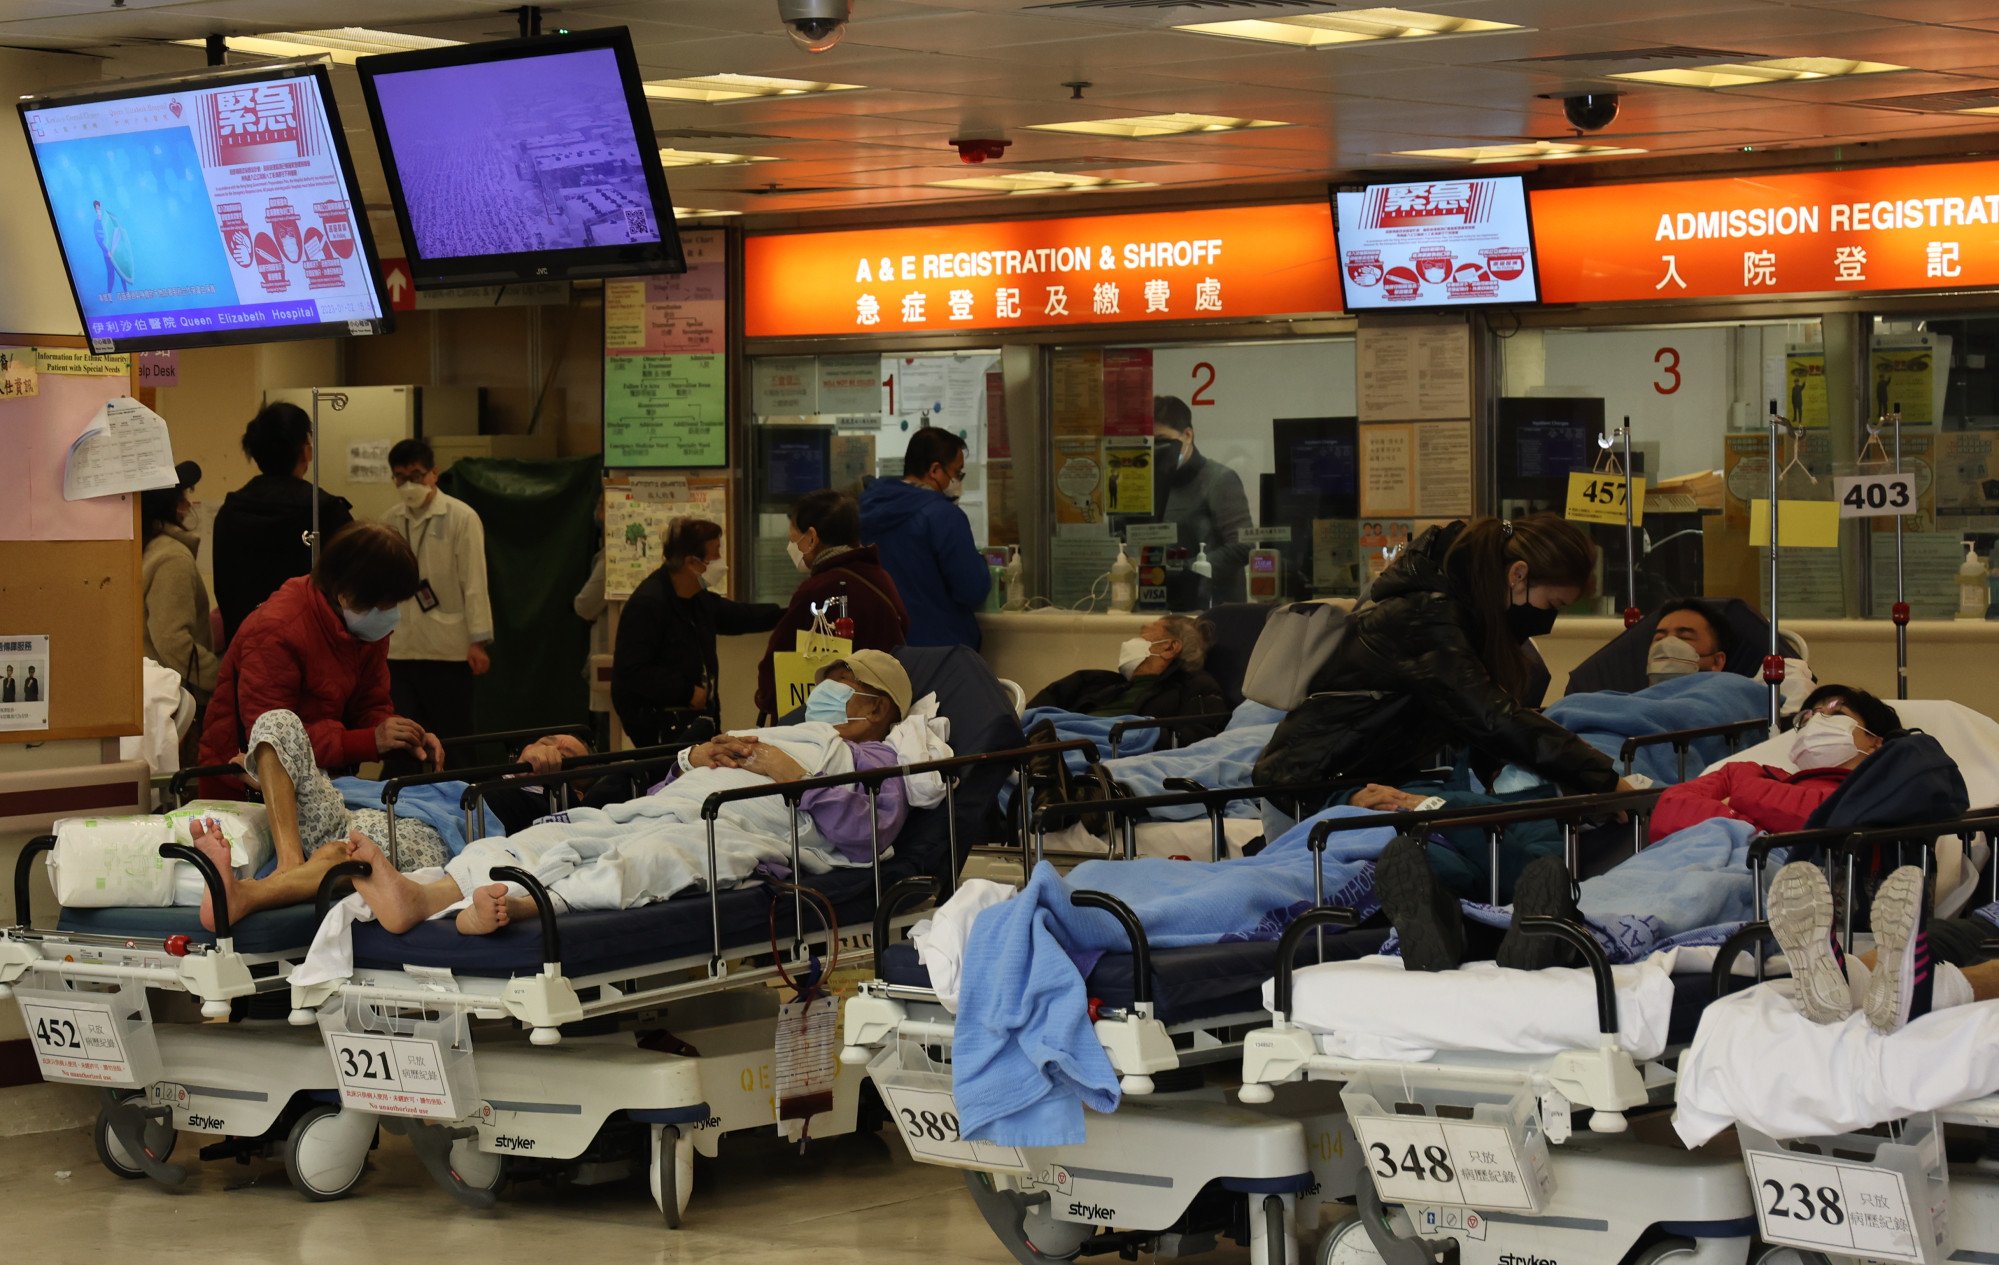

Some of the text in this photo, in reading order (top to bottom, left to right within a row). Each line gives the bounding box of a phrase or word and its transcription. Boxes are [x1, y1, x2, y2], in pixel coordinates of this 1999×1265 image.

[217, 86, 297, 136] 緊急
[1385, 183, 1471, 213] 緊急
[1655, 206, 1818, 242] ADMISSION
[536, 267, 548, 275] JVC
[856, 239, 1223, 283] A & E REGISTRATION & SHROFF
[1655, 242, 1962, 291] 入院登記
[856, 277, 1223, 325] 急症登記及繳費處
[91, 306, 314, 335] 伊利沙伯醫院 Queen Elizabeth Hospital
[37, 352, 73, 362] Information
[73, 352, 83, 361] for
[104, 354, 128, 364] Minority
[46, 363, 68, 372] Patient
[83, 364, 103, 374] Special
[104, 365, 121, 373] Needs
[153, 364, 176, 377] Desk
[1653, 346, 1681, 395] 3
[882, 373, 894, 415] 1
[1191, 361, 1216, 406] 2
[1582, 480, 1626, 506] 457
[1843, 481, 1910, 509] 403
[1142, 589, 1166, 600] VISA
[36, 1017, 81, 1049] 452
[340, 1047, 395, 1081] 321
[407, 1055, 425, 1066] 只放
[70, 1070, 103, 1080] unauthorized
[369, 1102, 379, 1110] No
[379, 1103, 417, 1114] unauthorized
[188, 1113, 225, 1131] stryker
[693, 1115, 722, 1130] ryker
[901, 1107, 960, 1142] 389
[495, 1135, 536, 1150] stryker
[1370, 1142, 1455, 1183] 348
[1469, 1150, 1498, 1165] 只放
[1461, 1168, 1518, 1185] 病歷紀錄
[1068, 1201, 1116, 1220] stryker
[1762, 1178, 1845, 1226] 238
[1860, 1192, 1889, 1209] 只放
[1850, 1211, 1908, 1232] 病歷紀錄
[1498, 1252, 1558, 1265] stryker
